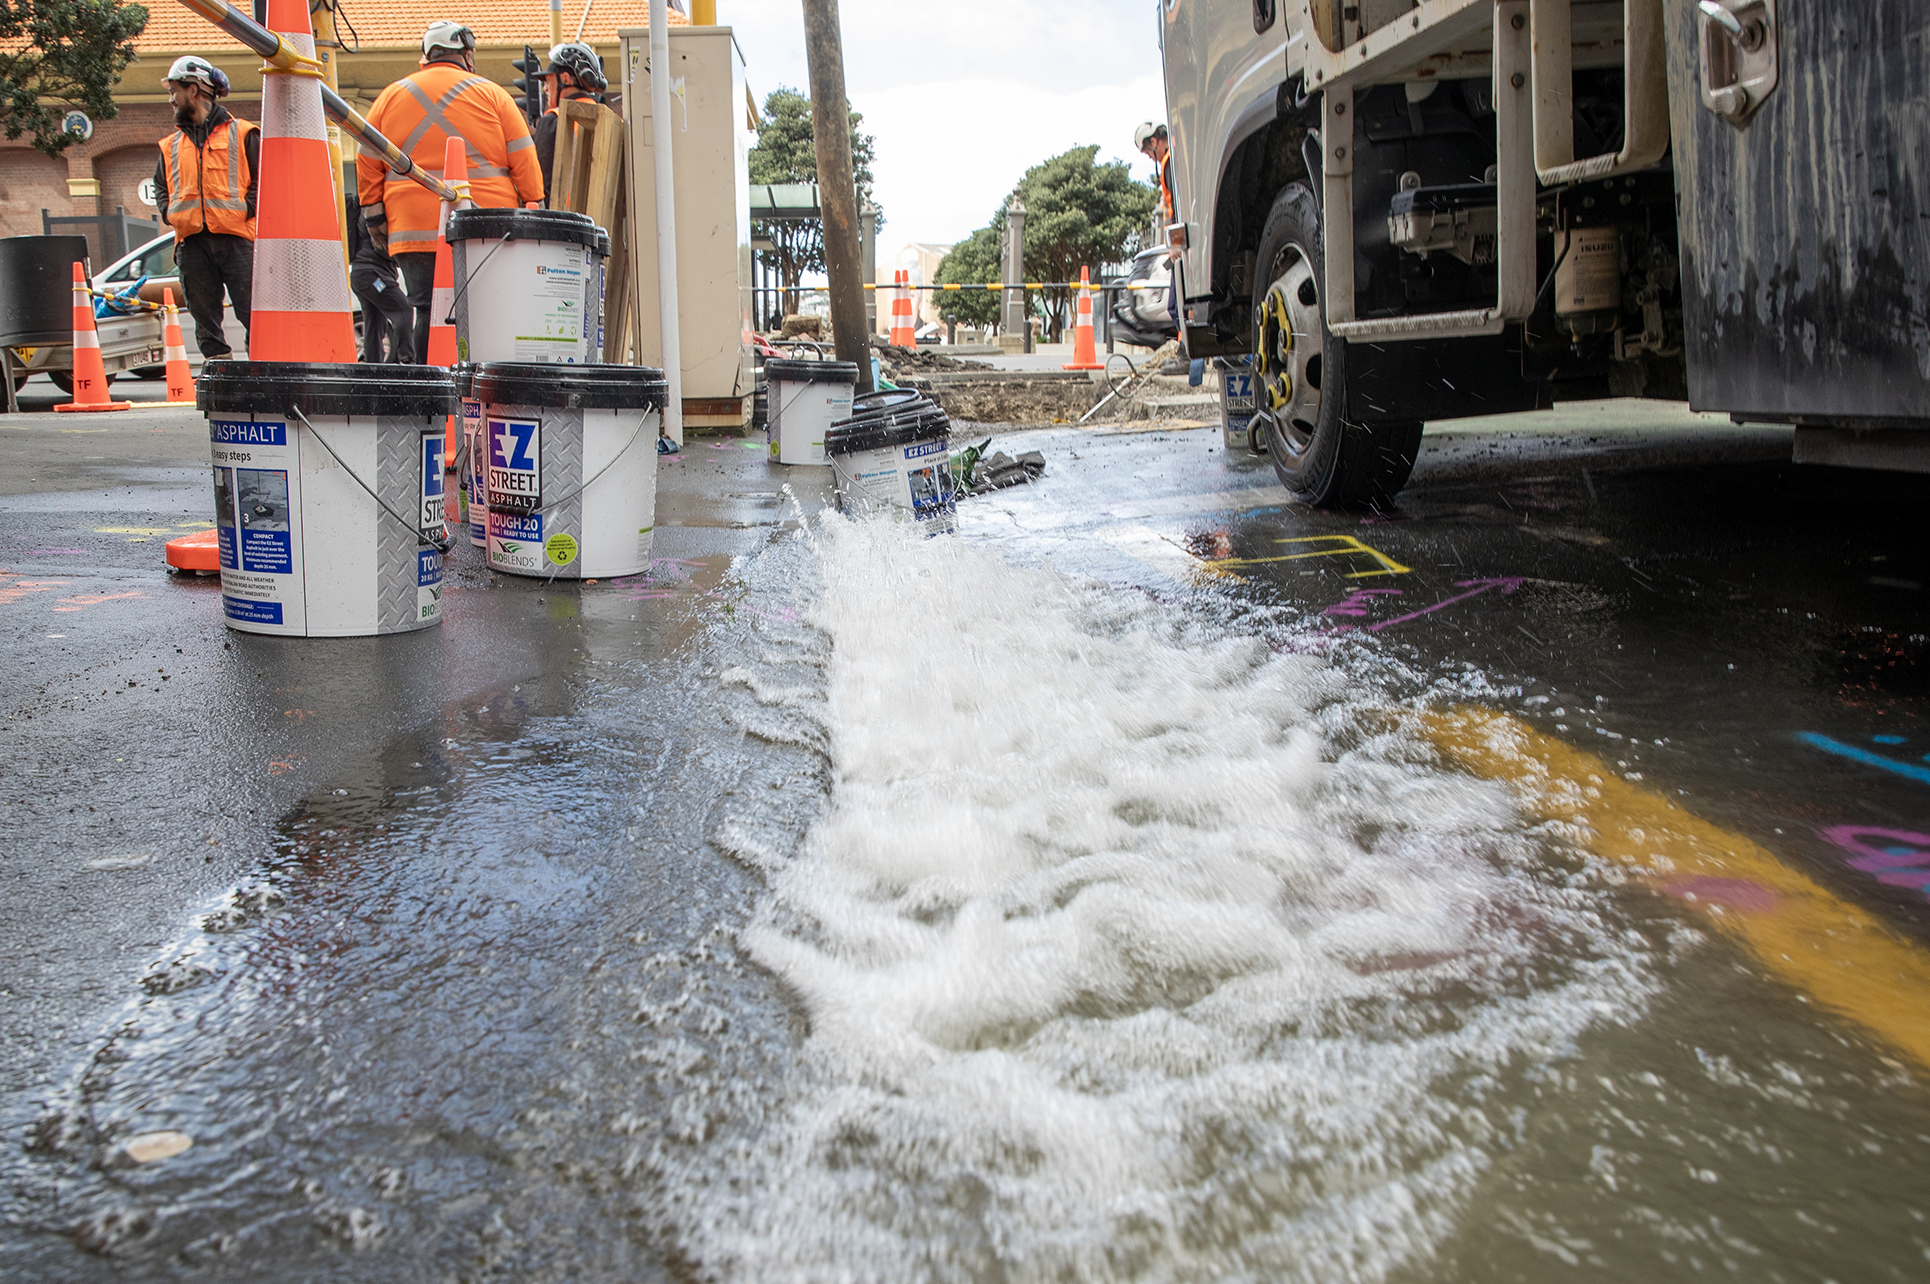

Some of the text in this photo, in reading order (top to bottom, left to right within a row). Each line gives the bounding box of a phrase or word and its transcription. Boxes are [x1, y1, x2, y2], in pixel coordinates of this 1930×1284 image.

[1581, 243, 1613, 253] ISUZU
[77, 380, 91, 389] TF
[1226, 376, 1252, 397] EZ
[171, 388, 183, 397] TF
[217, 424, 278, 442] ASPHALT
[489, 421, 536, 471] EZ
[216, 451, 228, 462] easy
[229, 451, 251, 463] steps
[909, 448, 919, 457] EZ
[490, 469, 536, 492] STREET
[491, 494, 536, 507] ASPHALT
[244, 513, 249, 523] 3
[491, 514, 521, 529] TOUGH
[523, 519, 538, 531] 20
[504, 529, 518, 537] READY
[492, 552, 535, 567] BIOBLENDS
